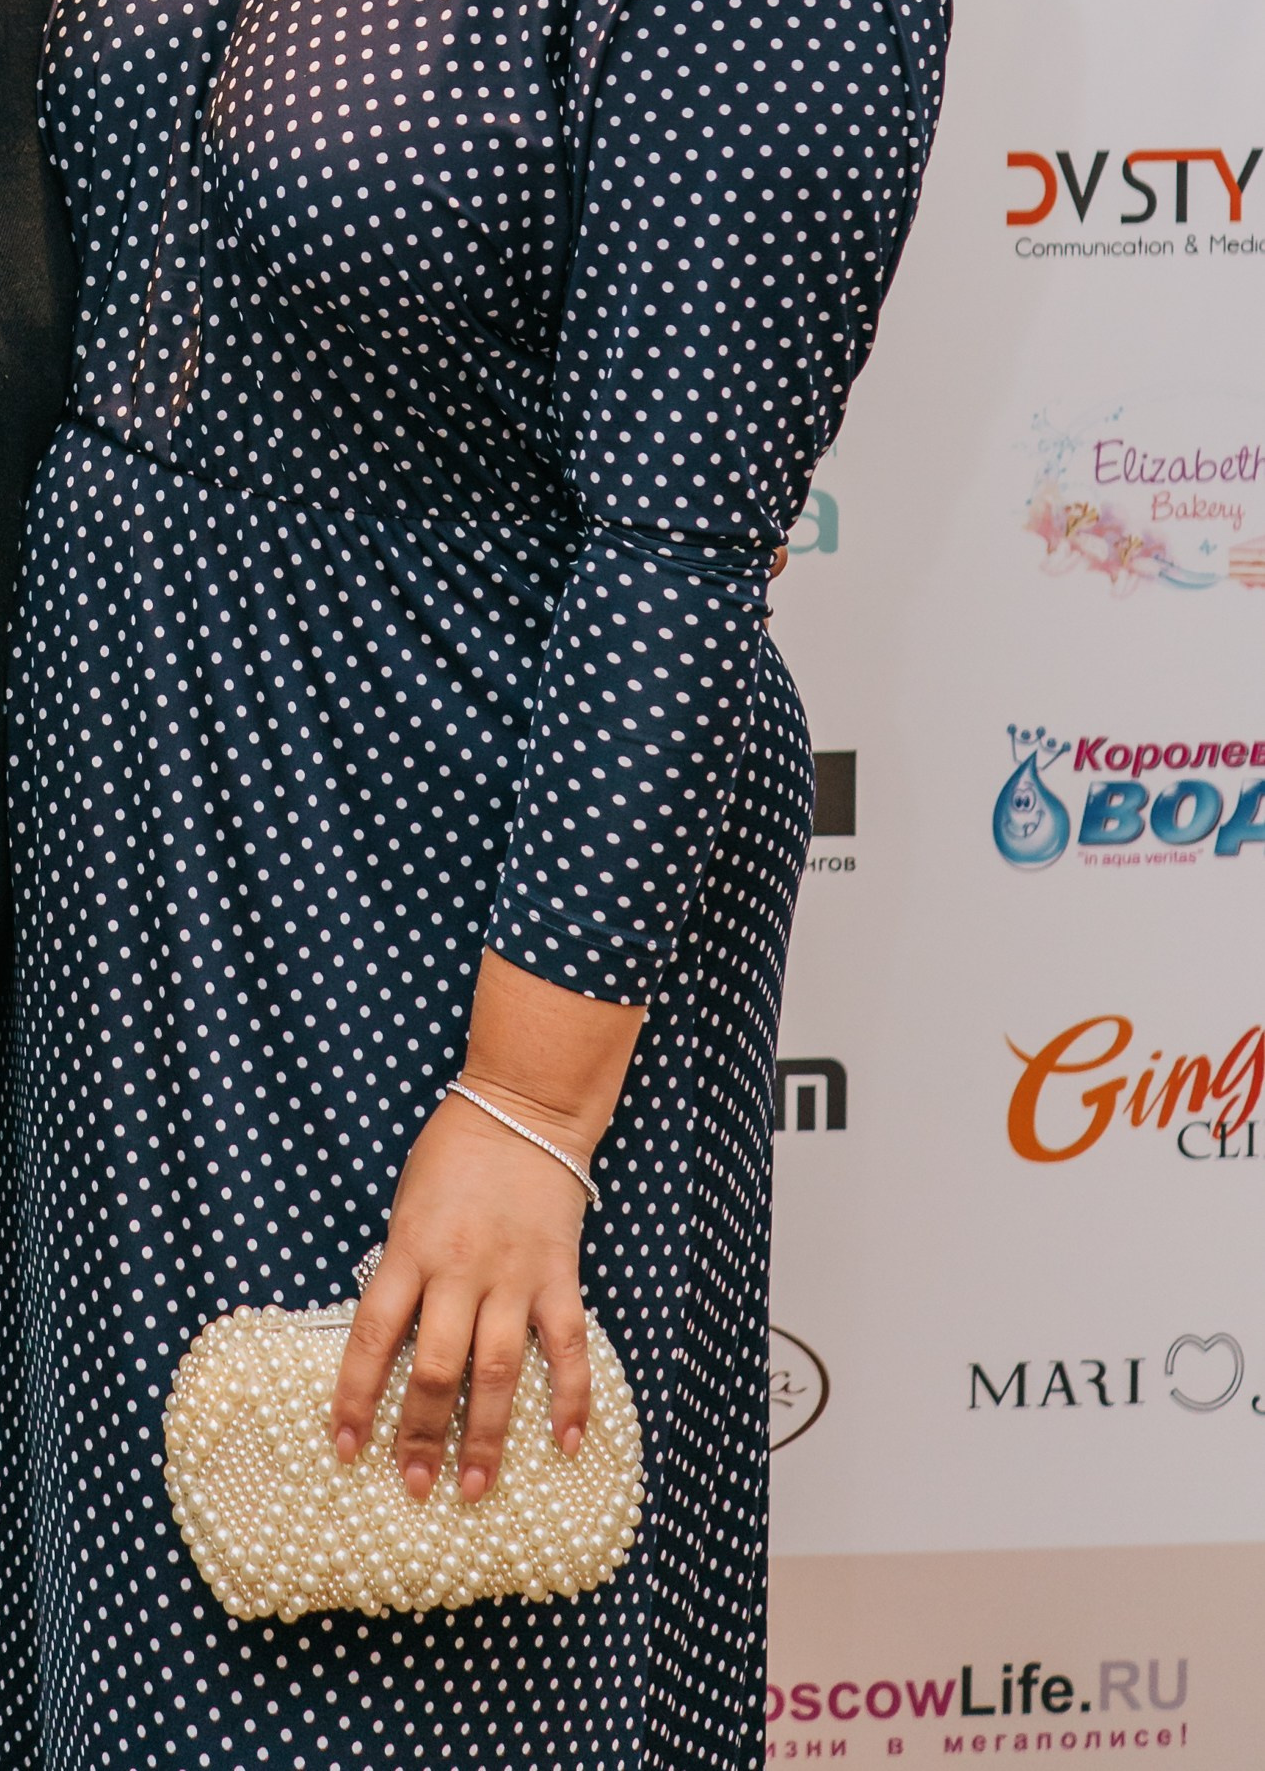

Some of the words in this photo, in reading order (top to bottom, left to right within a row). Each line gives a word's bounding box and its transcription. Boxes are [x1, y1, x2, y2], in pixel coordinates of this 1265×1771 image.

[1015, 235, 1174, 259] Communication
[1184, 234, 1199, 255] &
[1094, 438, 1265, 485] Elizabeth
[1151, 490, 1245, 531] Bakery
[1102, 851, 1140, 868] aqua
[968, 1357, 1146, 1409] MARI
[887, 1737, 904, 1757] в
[943, 1723, 1189, 1754] мегаполисе!
